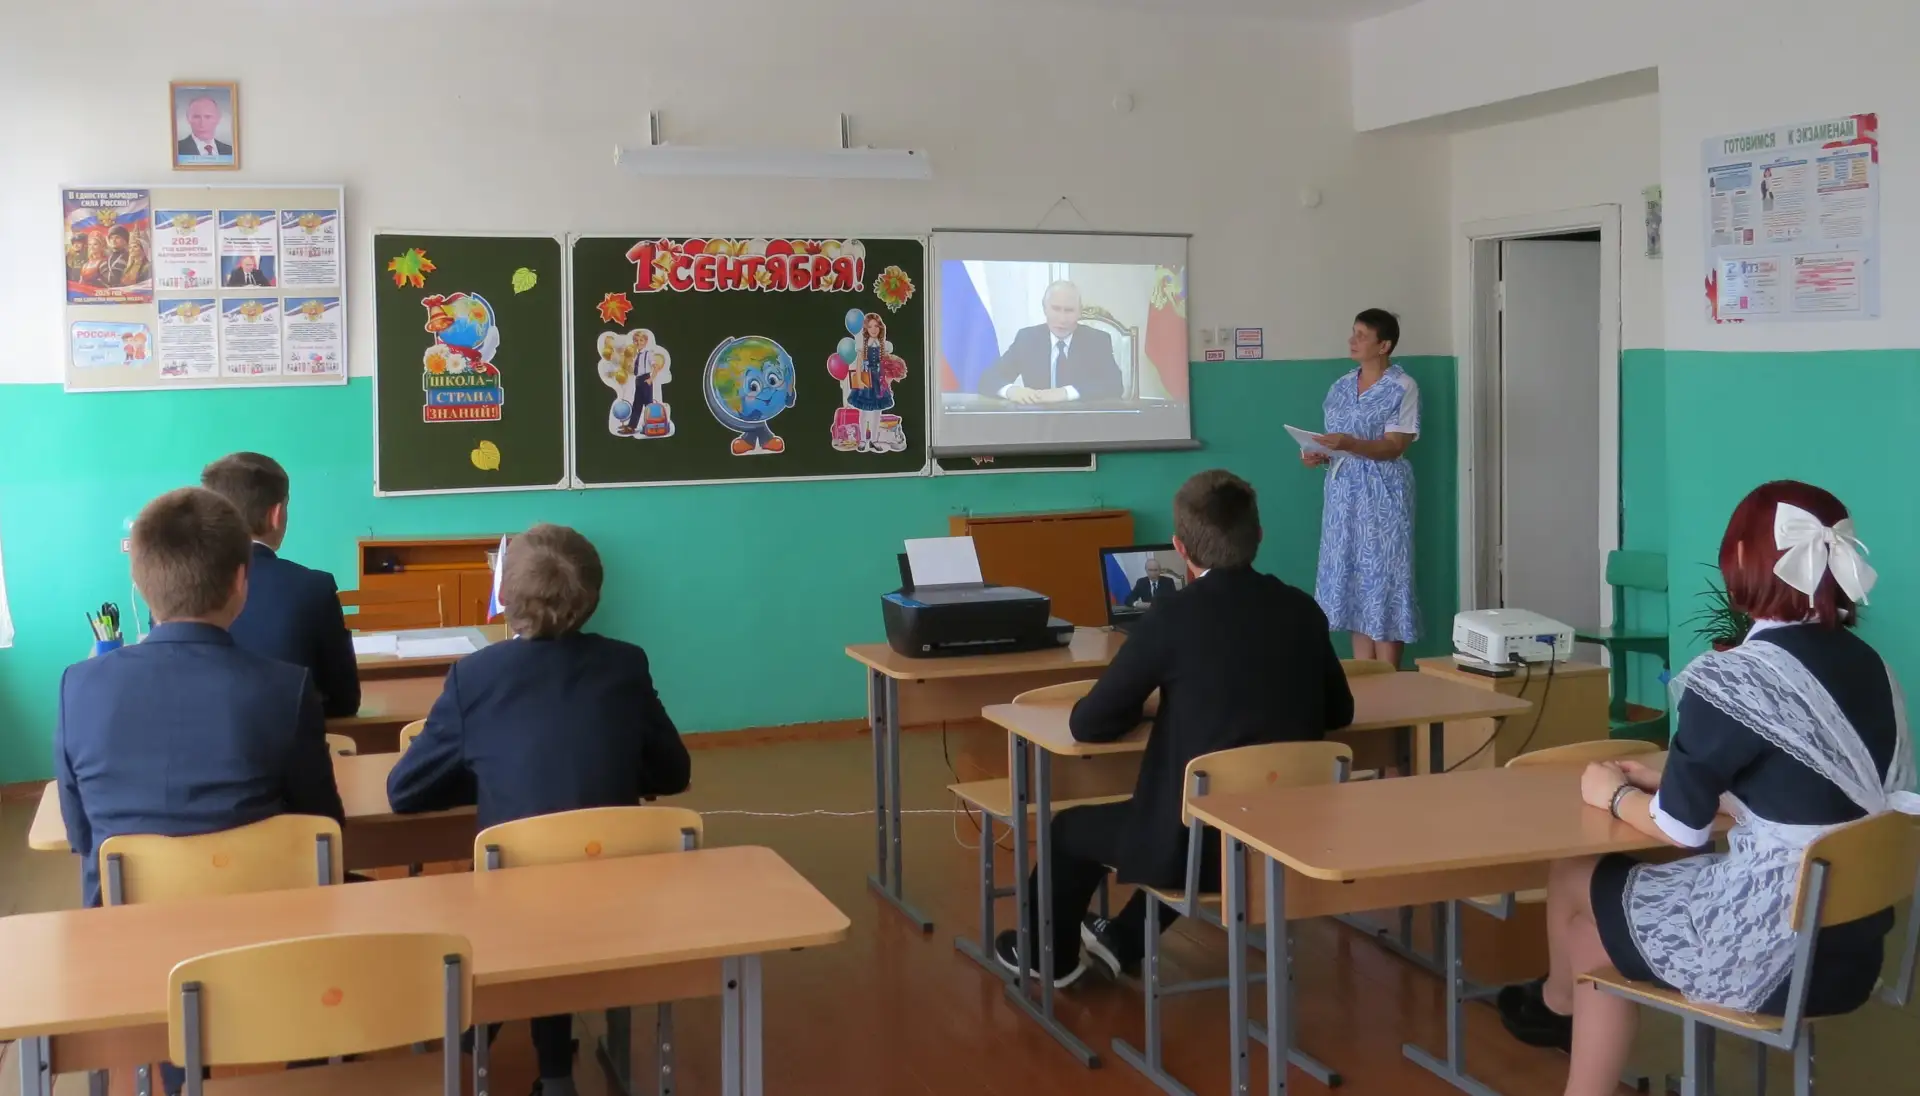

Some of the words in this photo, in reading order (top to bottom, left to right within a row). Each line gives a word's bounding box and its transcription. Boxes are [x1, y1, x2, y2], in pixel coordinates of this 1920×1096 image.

[1724, 132, 1776, 155] ГОТОВИМСЯ
[1788, 130, 1794, 145] К
[1796, 120, 1855, 144] ЭКЗАМЕНАМ
[172, 237, 199, 246] 2026
[627, 241, 658, 292] 1
[668, 254, 864, 292] СЕНТЯБРЯ!
[436, 391, 494, 403] СТРАНА
[429, 404, 497, 420] ЗНАНИЙ!
